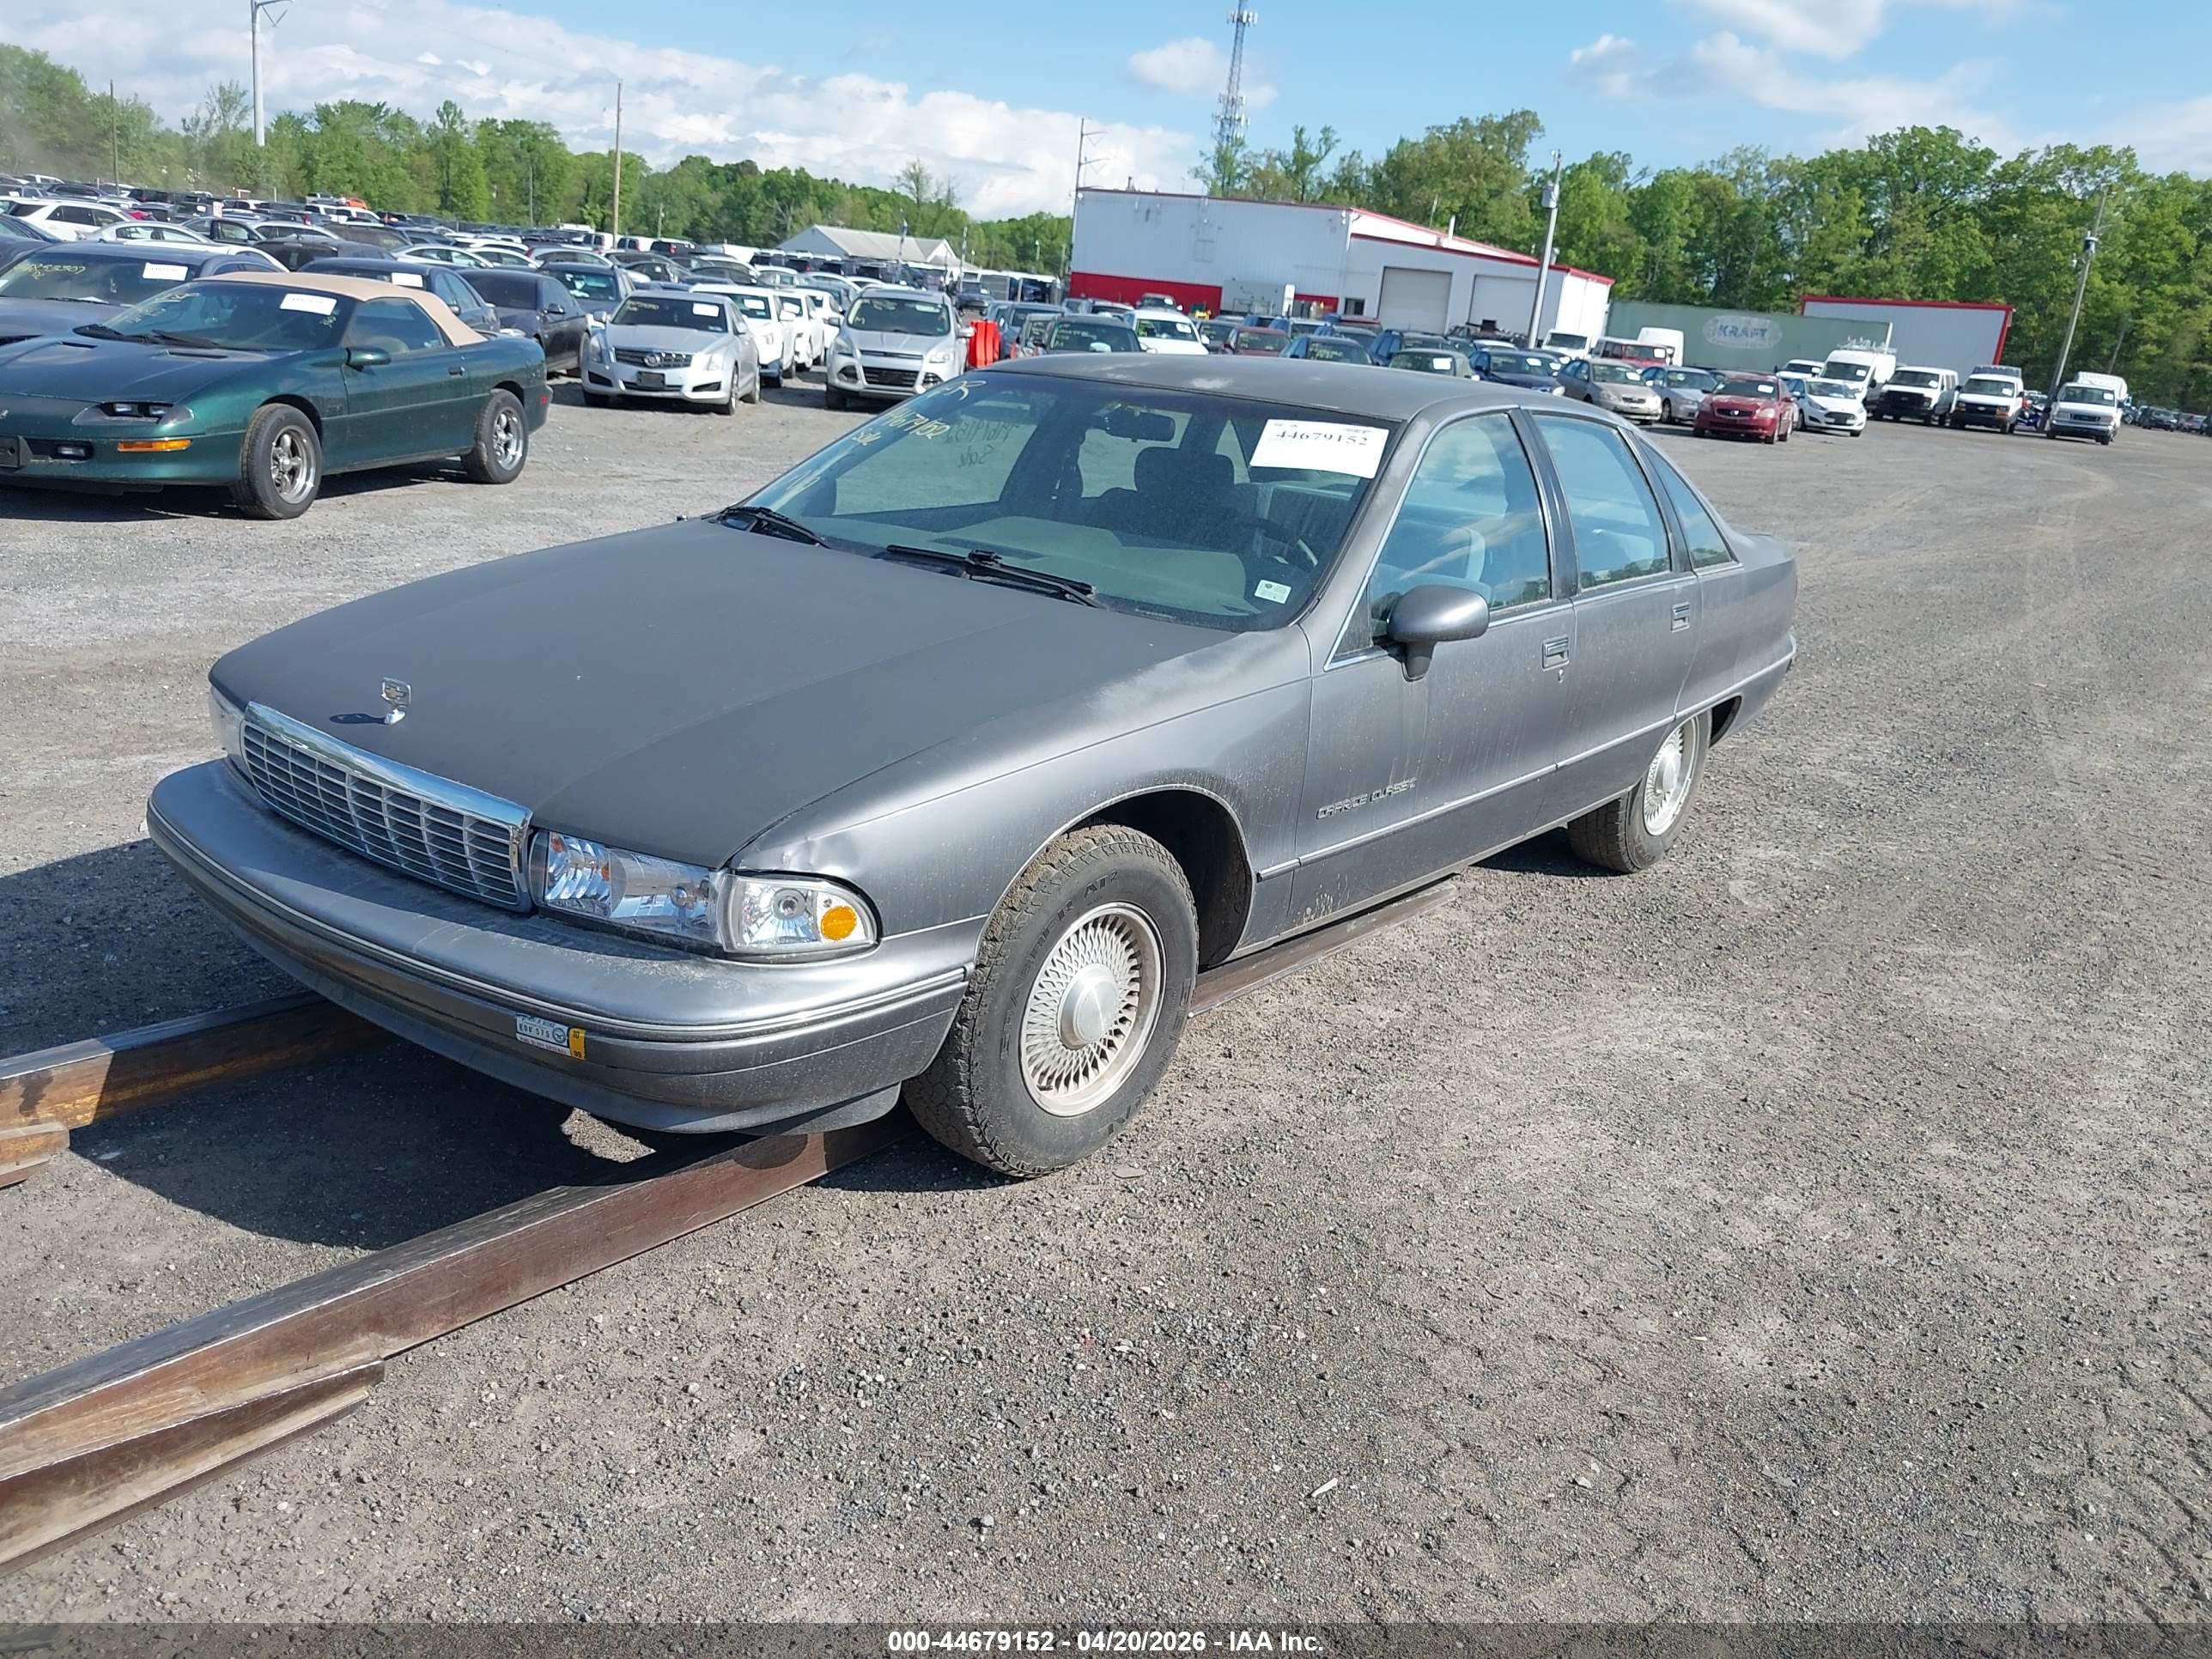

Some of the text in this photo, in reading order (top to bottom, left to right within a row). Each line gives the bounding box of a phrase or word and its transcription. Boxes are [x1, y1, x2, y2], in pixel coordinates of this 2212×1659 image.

[1718, 325, 1768, 338] KRAFT
[1276, 429, 1368, 447] 44679152
[1316, 793, 1368, 820] CAPRICE
